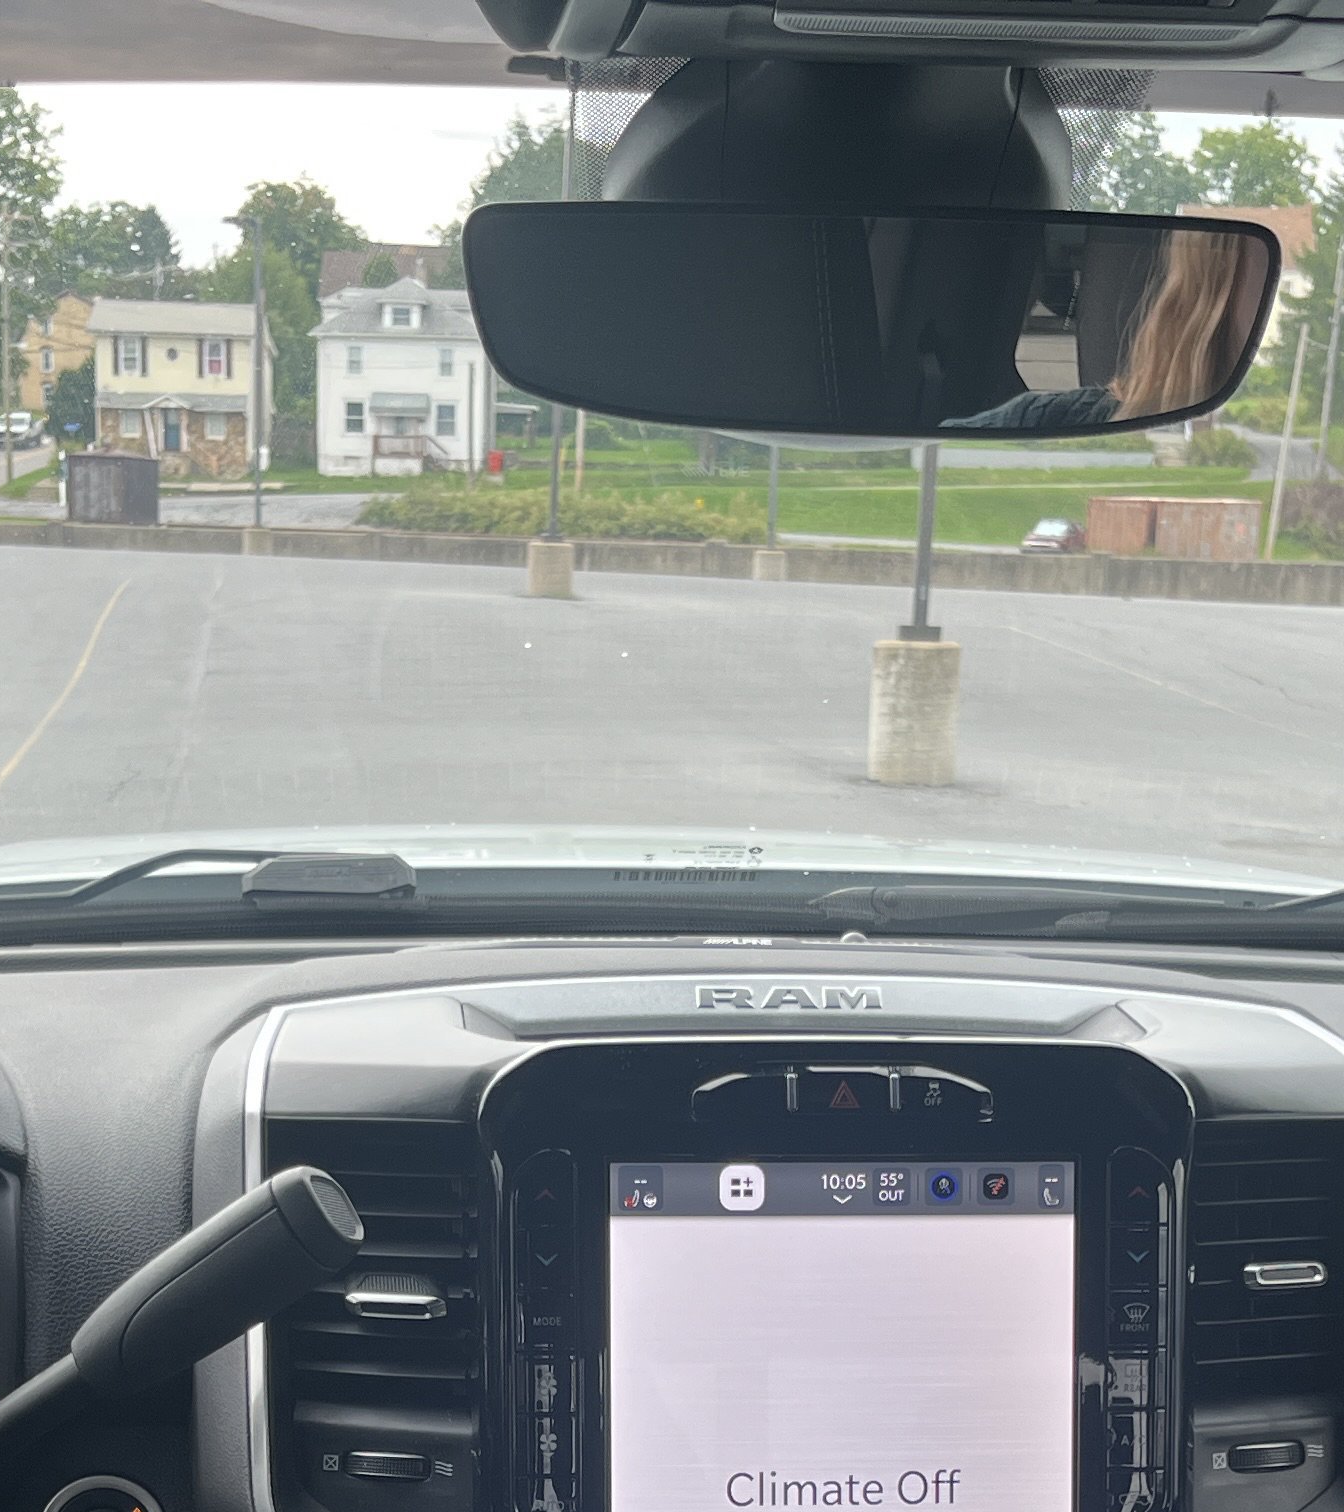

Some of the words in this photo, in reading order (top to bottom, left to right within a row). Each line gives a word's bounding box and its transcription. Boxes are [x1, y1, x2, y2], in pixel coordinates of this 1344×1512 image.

[695, 985, 883, 1010] RAM
[821, 1174, 866, 1190] 10:05
[878, 1189, 905, 1202] OUT
[532, 1316, 562, 1327] MODE
[726, 1470, 884, 1507] Climate
[897, 1468, 962, 1505] Off
